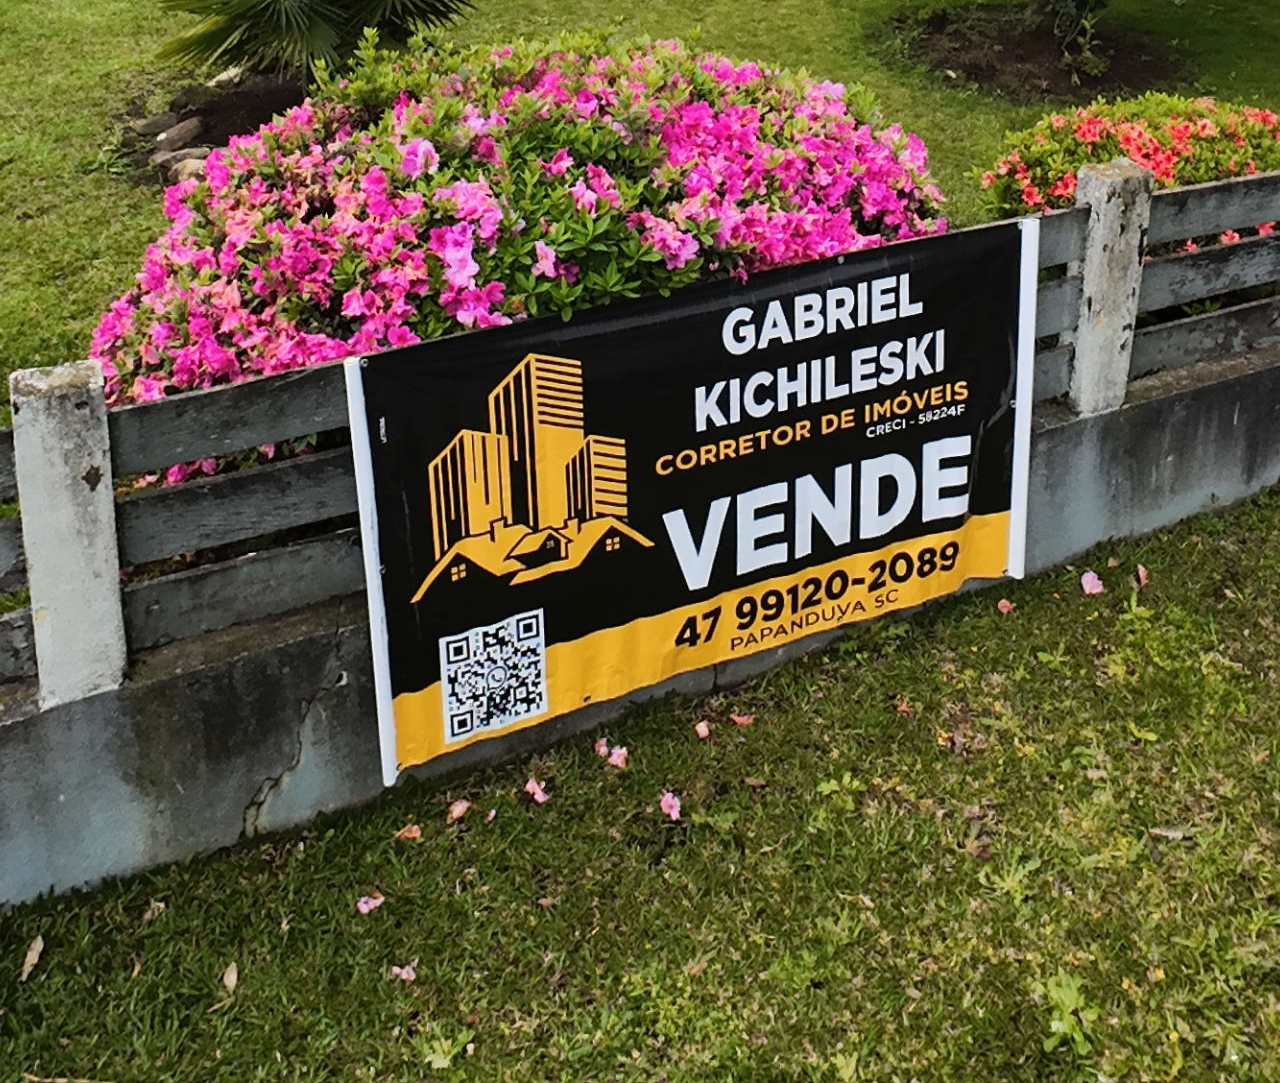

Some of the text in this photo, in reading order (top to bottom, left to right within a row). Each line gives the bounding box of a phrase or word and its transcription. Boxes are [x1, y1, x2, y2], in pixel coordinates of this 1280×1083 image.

[722, 273, 923, 355] GABRIEL
[695, 329, 945, 432] KICHILESKI
[866, 418, 906, 437] CRECI
[655, 381, 969, 475] CORRETOR DE IMÓVEIS
[662, 435, 971, 591] VENDE
[675, 541, 959, 647] 47 99120-2089
[731, 589, 899, 651] PAPANDUVA SC
